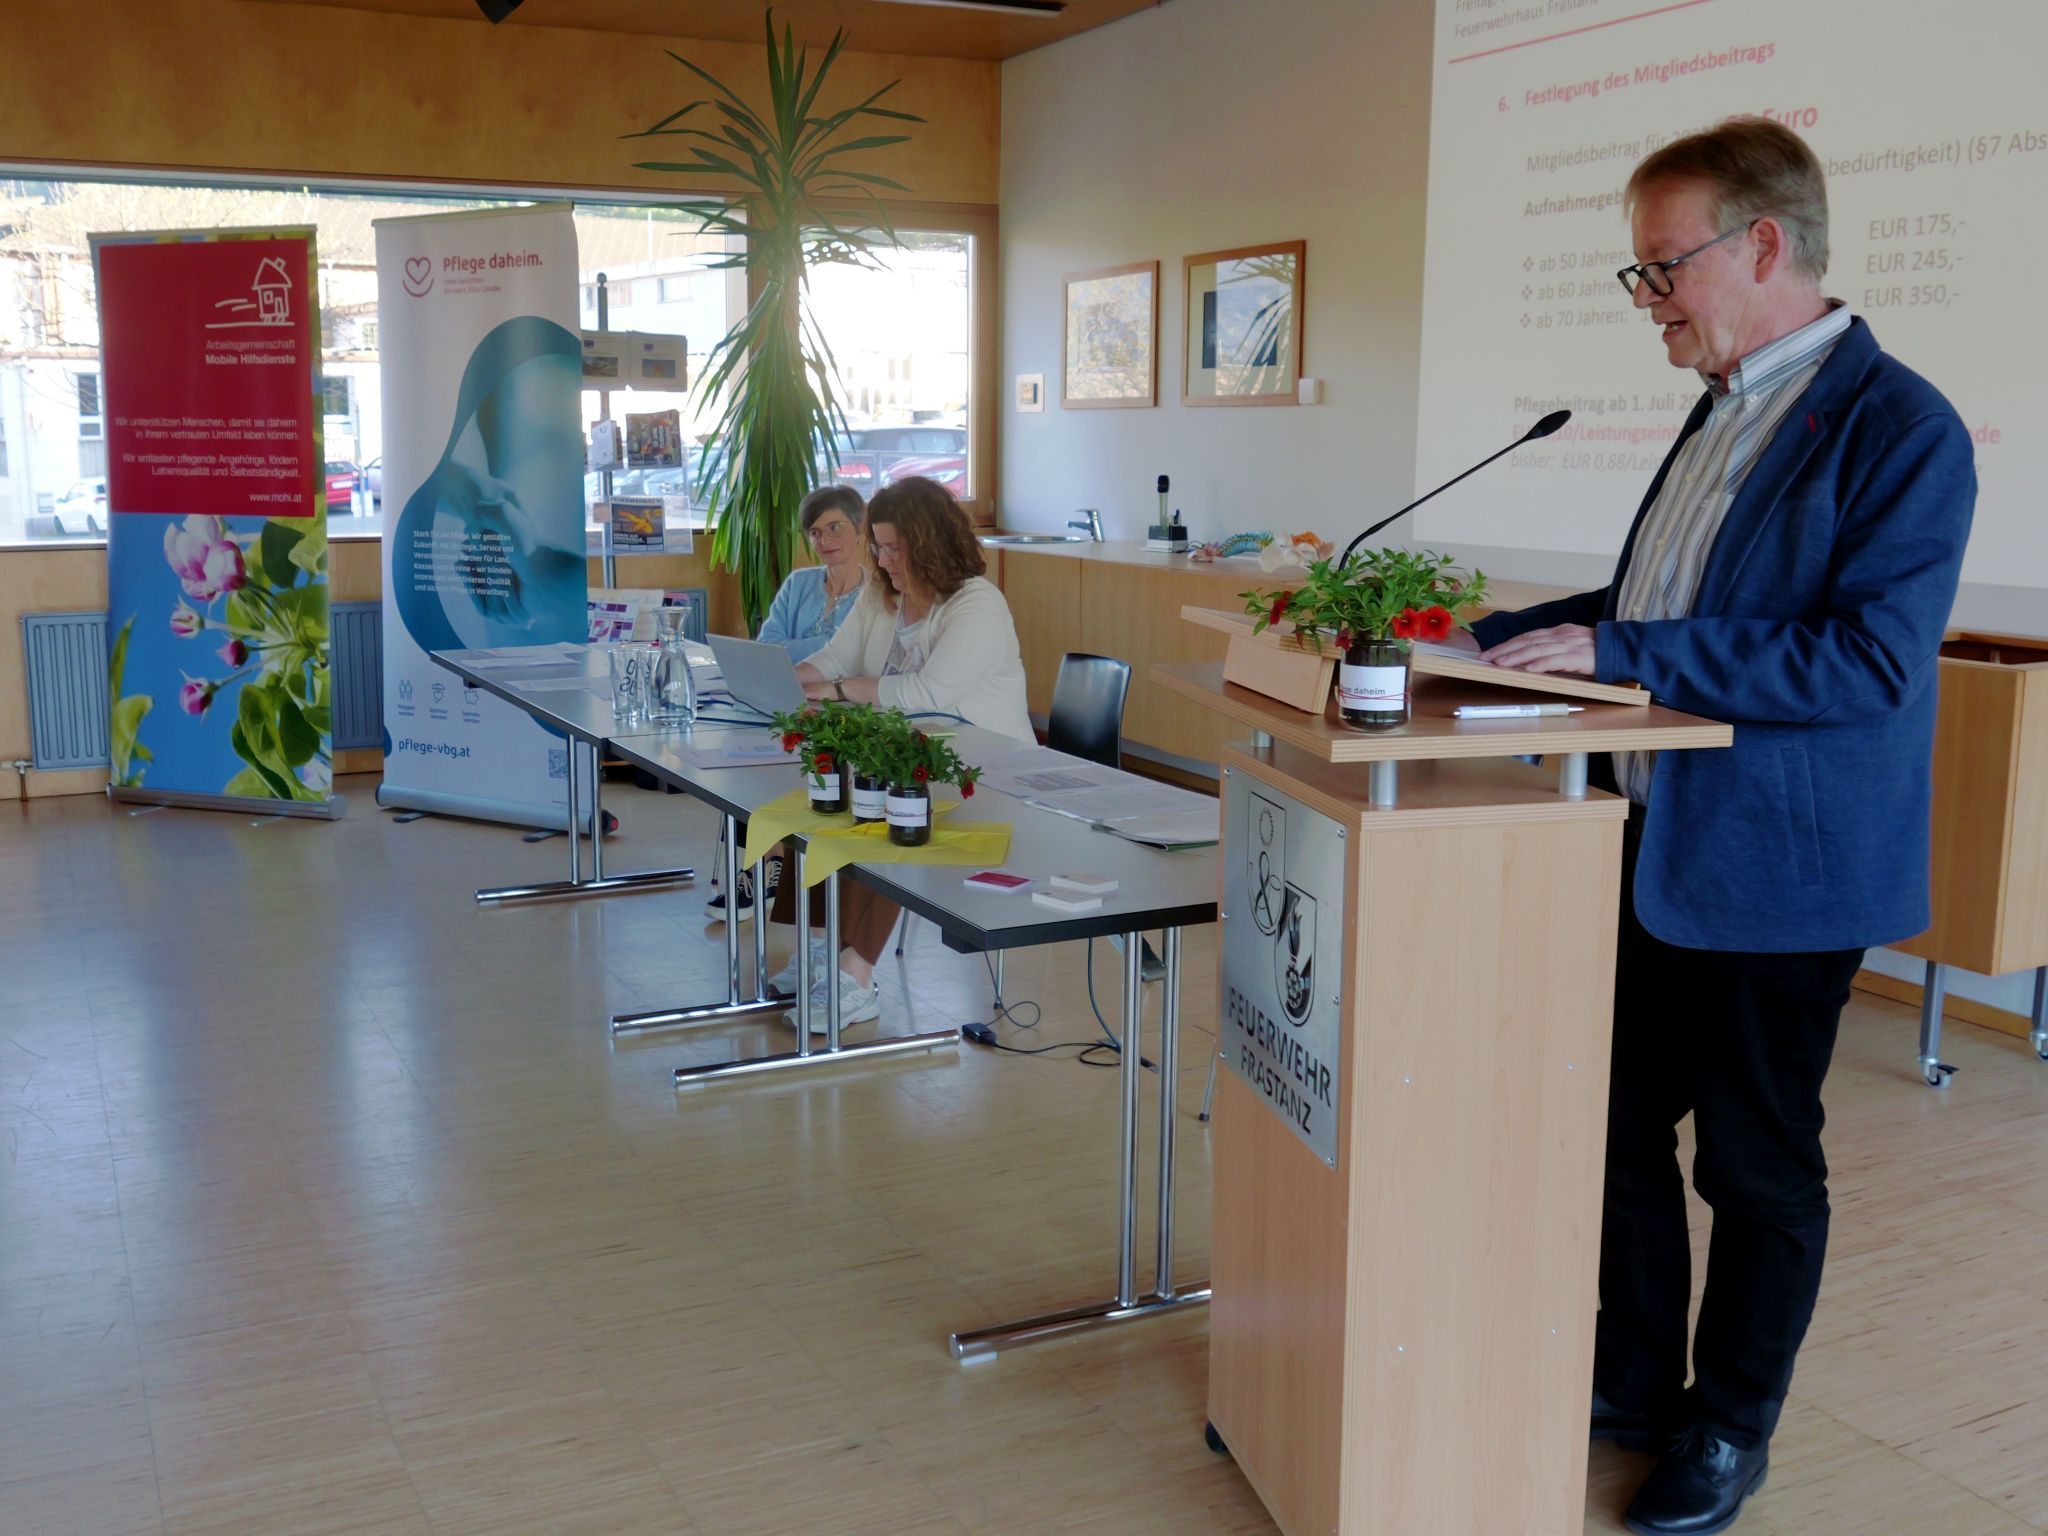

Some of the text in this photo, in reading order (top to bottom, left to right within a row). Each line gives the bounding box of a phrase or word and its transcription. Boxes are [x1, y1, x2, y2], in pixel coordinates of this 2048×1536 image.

[1455, 5, 1544, 38] Feuerwehrhaus
[1498, 42, 1776, 112] 6. Festlegung des Mitgliedsbeitrags
[1526, 134, 1667, 173] Mitgliedsbeitrag für
[1968, 135, 2003, 165] (§7
[1524, 188, 1623, 217] Aufnahmegeb
[1869, 213, 1967, 240] EUR 175,-
[443, 250, 543, 274] Pflege daheim.
[1539, 254, 1556, 273] ab
[1559, 252, 1577, 271] 50
[1866, 248, 1963, 274] EUR 245,-
[1538, 282, 1554, 301] ab
[1557, 281, 1576, 299] 60
[1864, 284, 1961, 308] EUR 350,-
[1536, 312, 1553, 329] ab
[1557, 311, 1574, 328] 70
[1577, 307, 1629, 328] Jahren:
[206, 338, 295, 353] Arbeitsgemeinschaft
[205, 353, 296, 365] Mobile Hilfsdienste
[1514, 393, 1700, 416] Pflegebeitrag ab 1. Juli 20
[114, 418, 127, 427] Wir
[229, 417, 251, 428] damit
[254, 418, 265, 427] sie
[267, 418, 297, 428] daheim
[170, 430, 210, 439] vertrauten
[212, 430, 242, 440] Umfeld
[243, 430, 265, 440] leben
[122, 453, 136, 463] Wir
[138, 453, 175, 463] entlasten
[177, 454, 216, 466] pflegende
[268, 455, 298, 465] fördern
[1562, 453, 1591, 469] EUR
[152, 465, 210, 477] Lebensqualität
[212, 467, 228, 477] und
[249, 492, 302, 503] www.mohi.at
[1354, 687, 1386, 696] daheim
[398, 738, 471, 759] pflege-vbg.at
[1228, 986, 1332, 1109] FEUERWEHR
[1241, 1045, 1312, 1135] FRASTANZ
